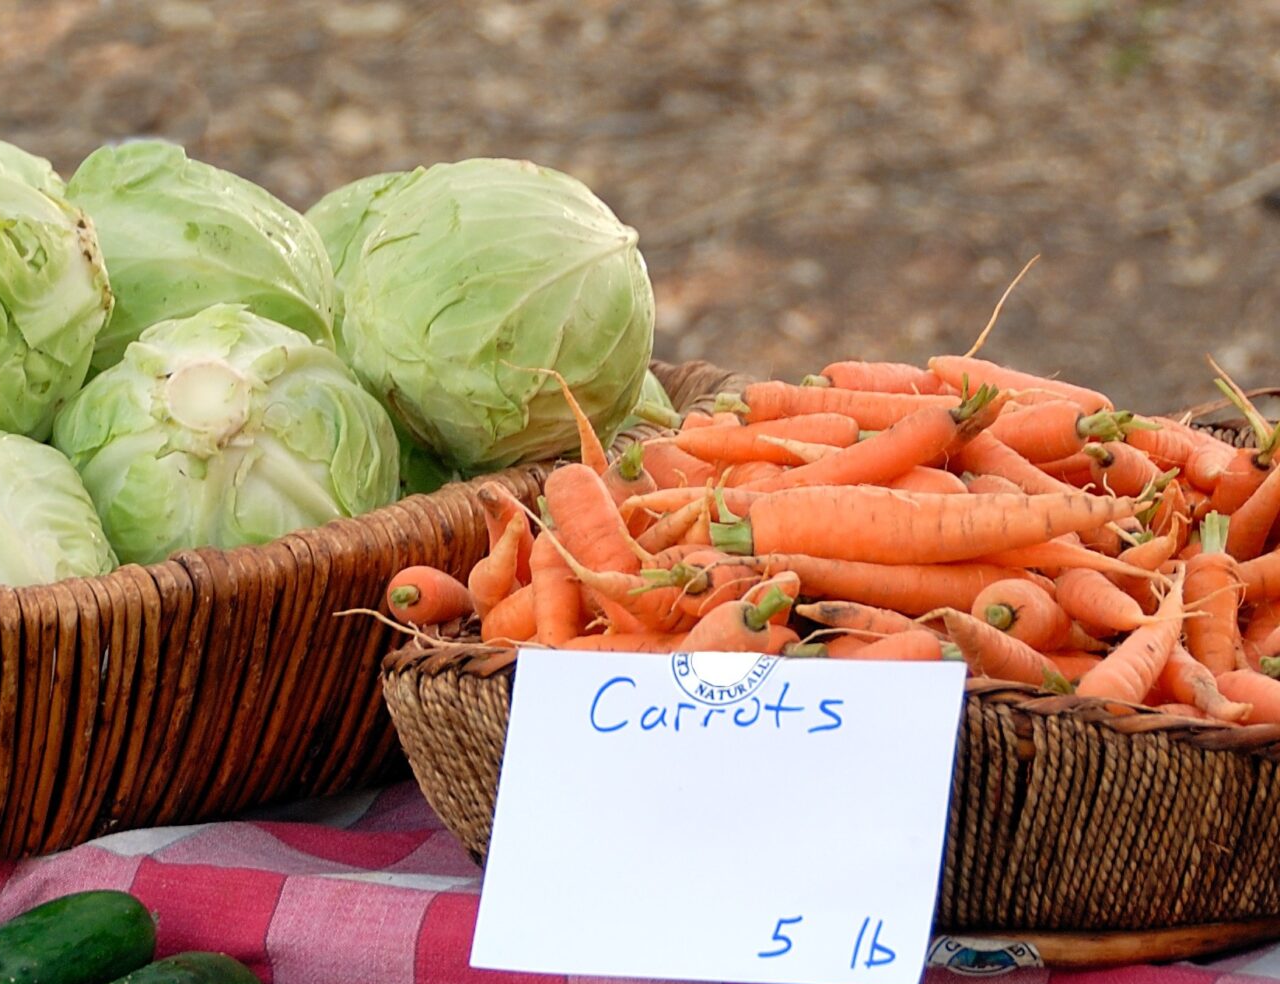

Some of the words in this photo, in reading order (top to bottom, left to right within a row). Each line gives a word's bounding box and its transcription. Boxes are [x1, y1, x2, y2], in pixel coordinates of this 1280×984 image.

[588, 675, 846, 733] Carrots
[756, 915, 805, 958] 5
[850, 915, 897, 970] lb
